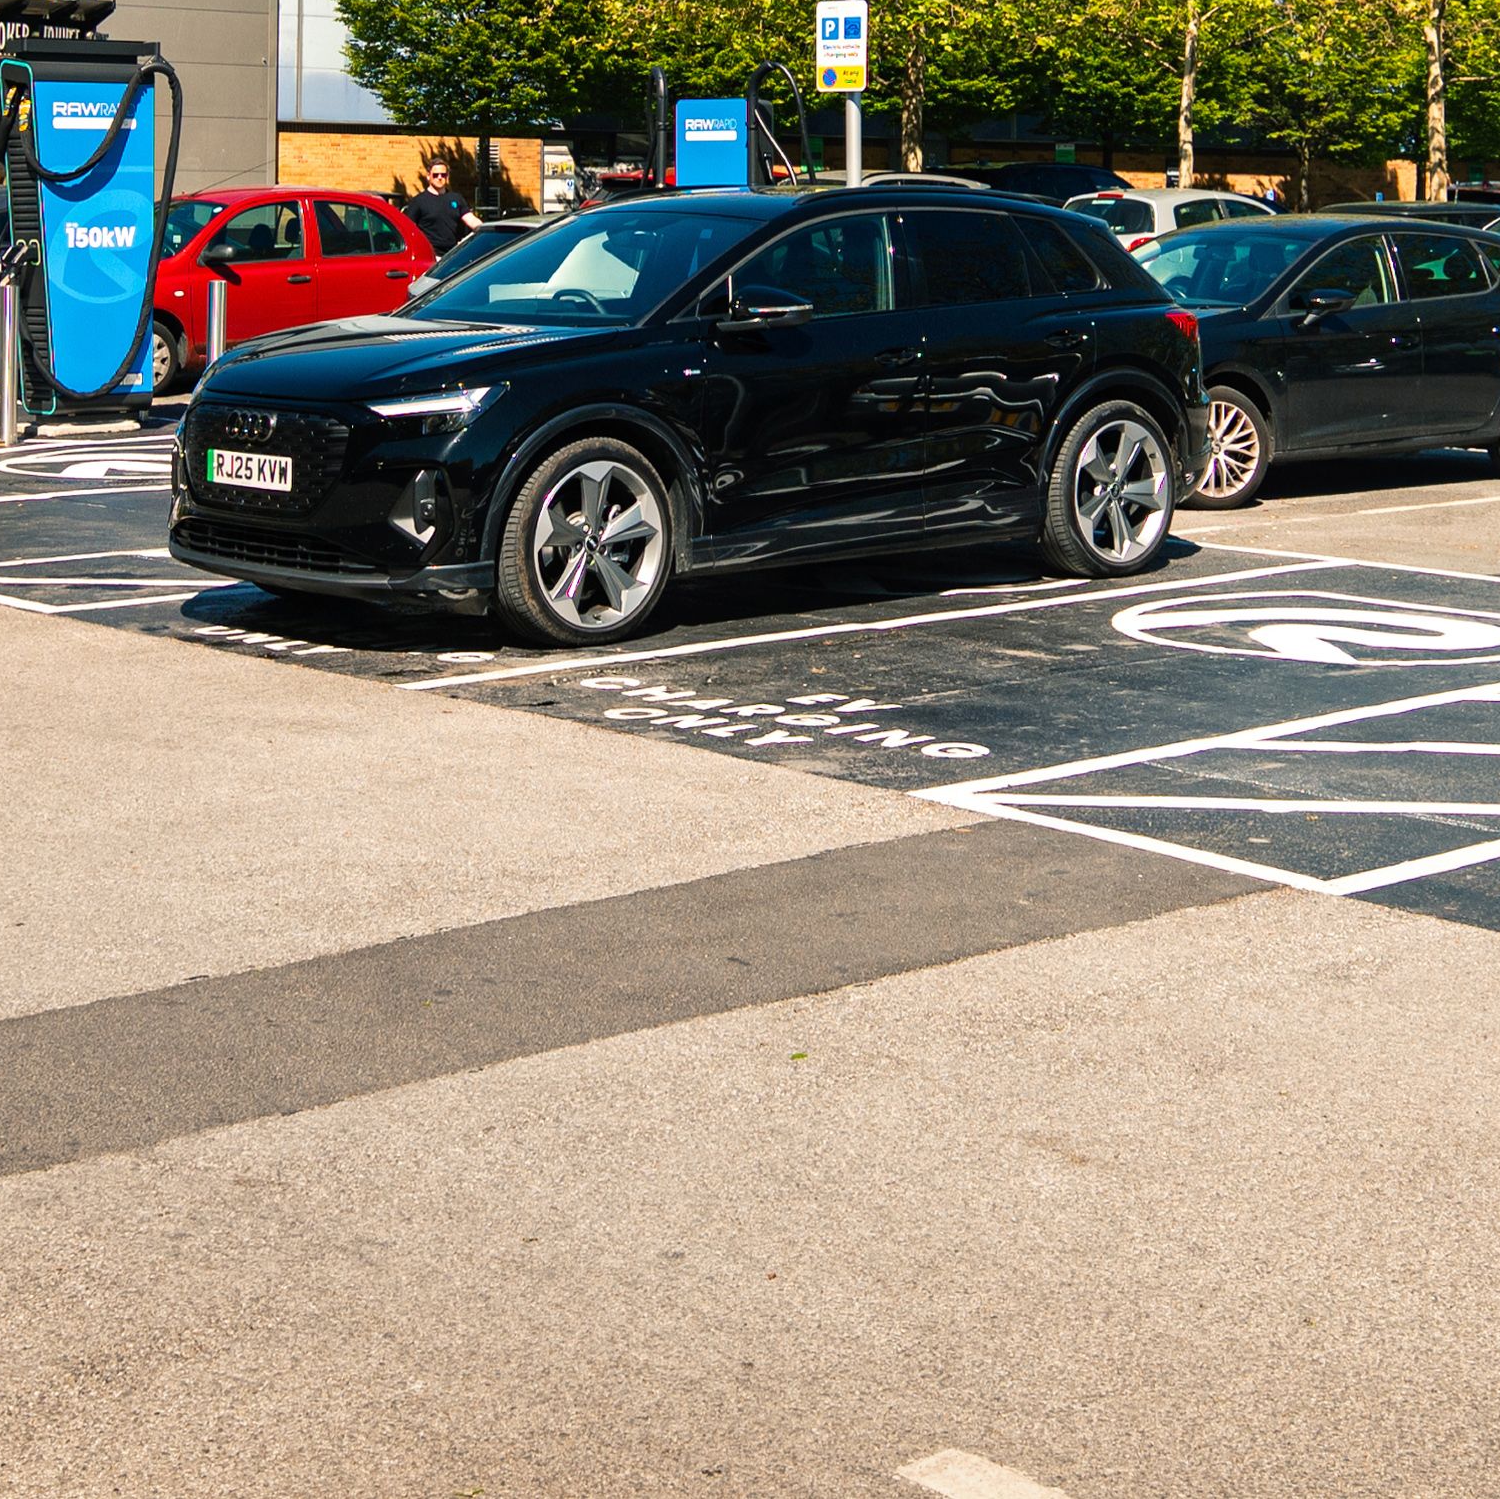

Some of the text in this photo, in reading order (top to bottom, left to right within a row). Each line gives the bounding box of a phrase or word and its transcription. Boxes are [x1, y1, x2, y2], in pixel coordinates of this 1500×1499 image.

[64, 226, 136, 249] 150kW
[216, 454, 288, 485] RJ25 KVW
[786, 692, 903, 712] EV
[579, 677, 990, 759] CHARGING
[603, 707, 814, 747] ONLY
